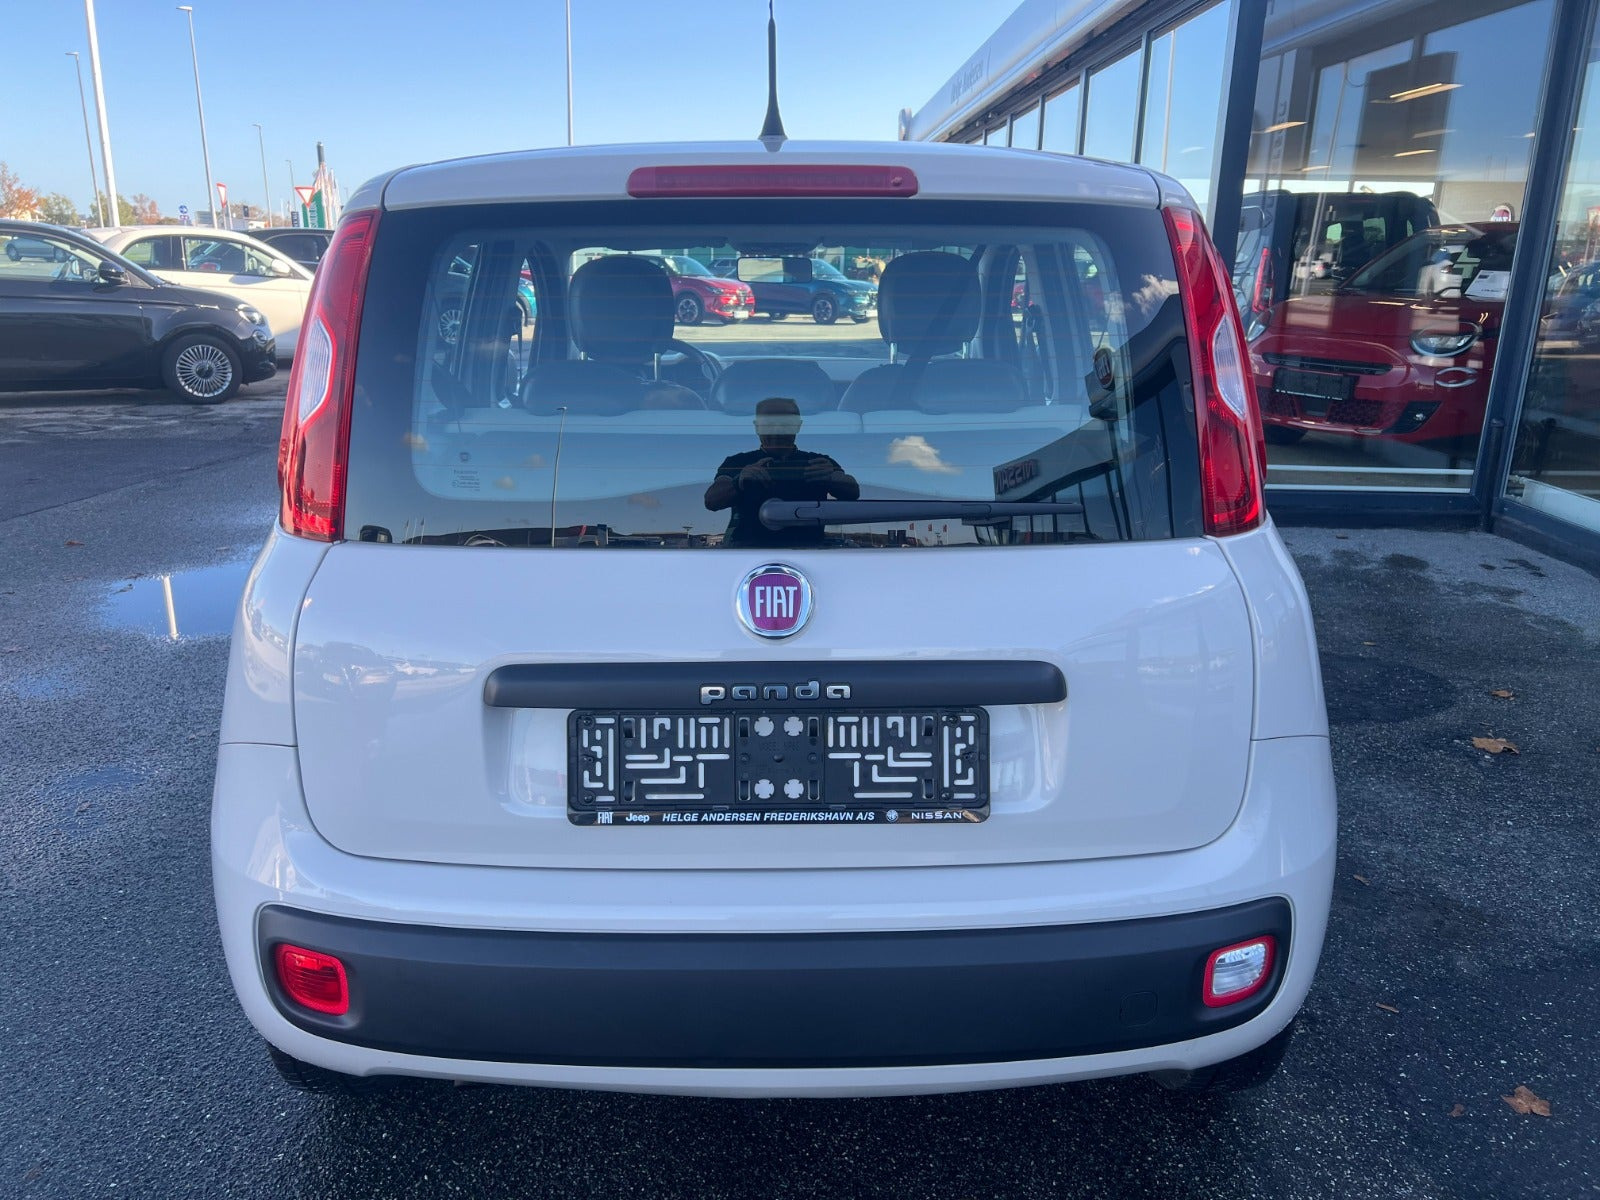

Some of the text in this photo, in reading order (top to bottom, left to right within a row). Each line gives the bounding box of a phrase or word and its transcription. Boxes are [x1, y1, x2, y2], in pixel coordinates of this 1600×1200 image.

[755, 586, 798, 618] FIAT
[700, 680, 851, 705] panda
[597, 811, 962, 824] FIAT Jeep HELGE ANDERSEN FREDERIKSHAVN A/S NISSAN
